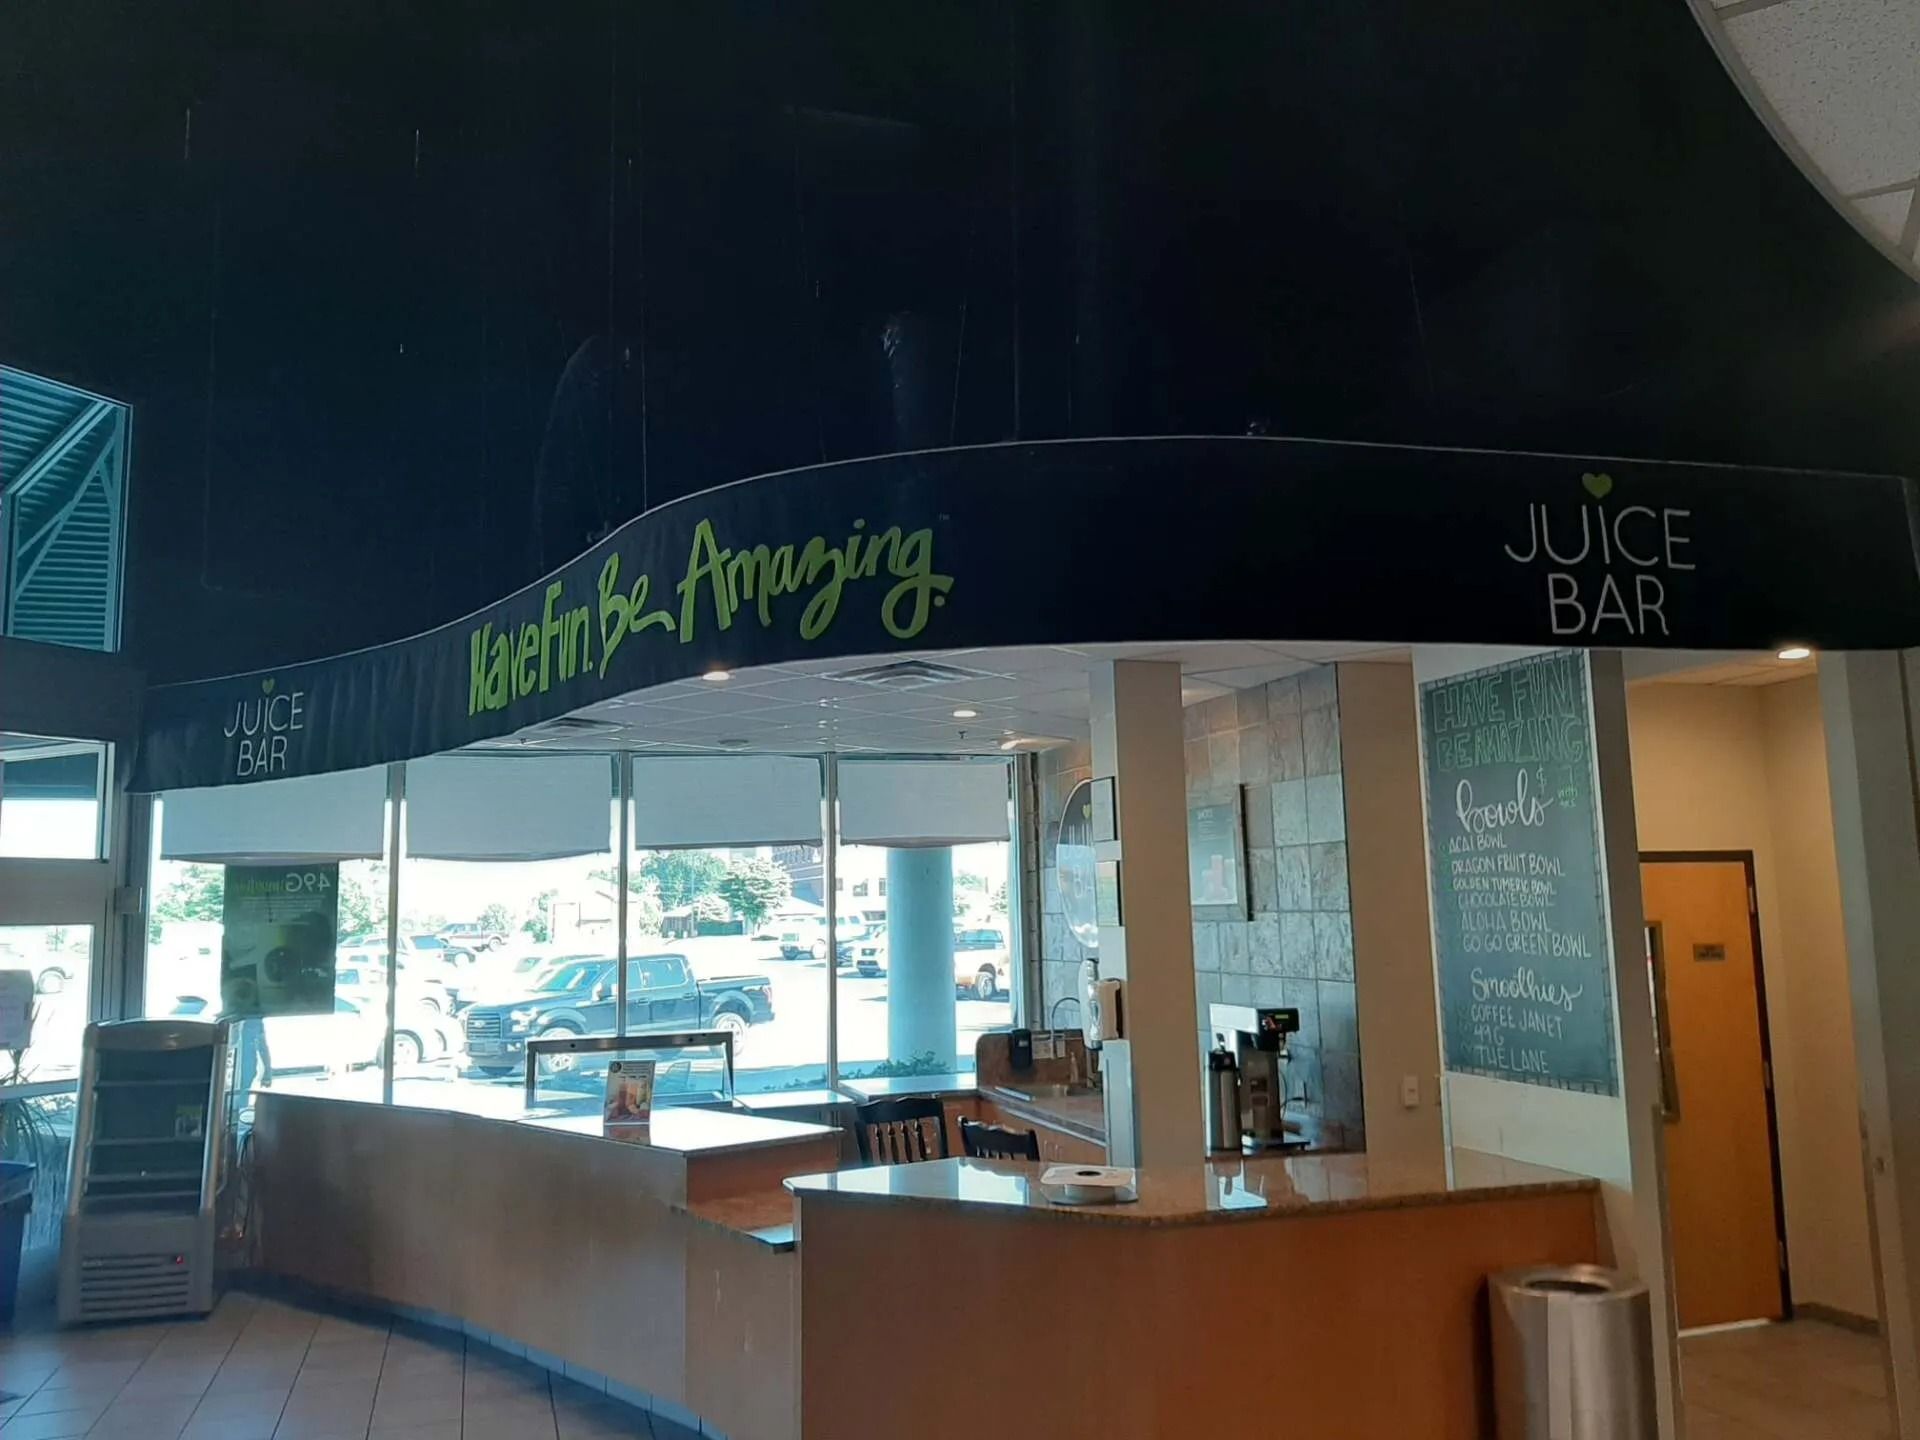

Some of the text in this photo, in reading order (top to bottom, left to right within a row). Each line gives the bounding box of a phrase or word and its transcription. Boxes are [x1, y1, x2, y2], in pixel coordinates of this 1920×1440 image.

[1504, 502, 1696, 570] JUICE
[1547, 572, 1670, 636] BAR
[469, 621, 541, 717] Have
[598, 551, 676, 680] Be
[1432, 656, 1577, 734] HAVE FUN
[223, 691, 304, 738] JUICE
[236, 735, 288, 777] BAR
[1476, 831, 1508, 850] BOWL
[1451, 851, 1567, 877] DRAGON FRUIT BOWL
[1452, 876, 1490, 891] GOLDEN
[1530, 880, 1558, 896] BOWL
[1457, 891, 1556, 910] CHOCOLATE BOWL
[1461, 909, 1553, 933] ALOHA BOWL
[1462, 932, 1593, 959] GO GO GREEN BOWL
[1469, 966, 1584, 1012] Smoothies
[1470, 1004, 1564, 1041] COFFEE JANET
[1472, 1045, 1550, 1075] THE LANE
